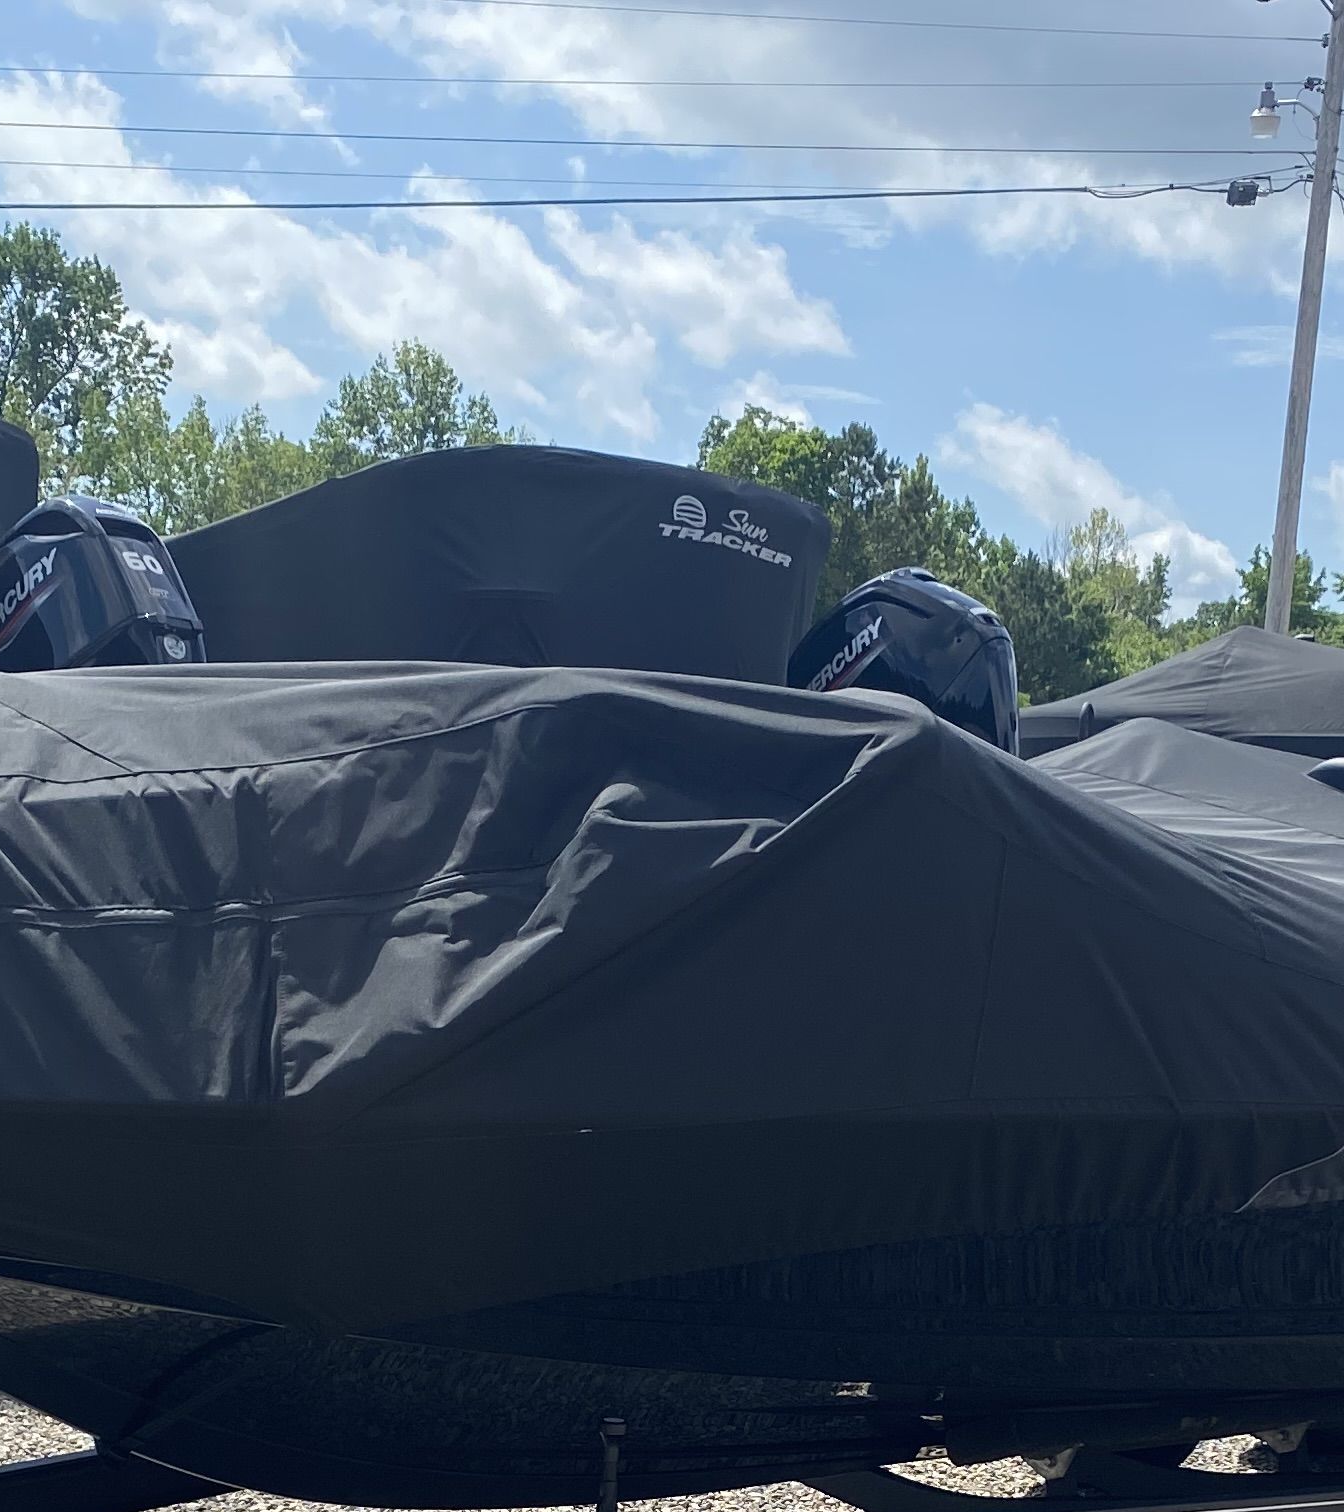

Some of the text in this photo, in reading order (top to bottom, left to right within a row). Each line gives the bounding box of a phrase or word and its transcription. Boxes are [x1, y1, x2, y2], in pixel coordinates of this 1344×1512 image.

[658, 522, 793, 567] TRACKER
[722, 509, 769, 542] Sun
[122, 551, 164, 575] 60
[806, 615, 883, 692] ERCURY
